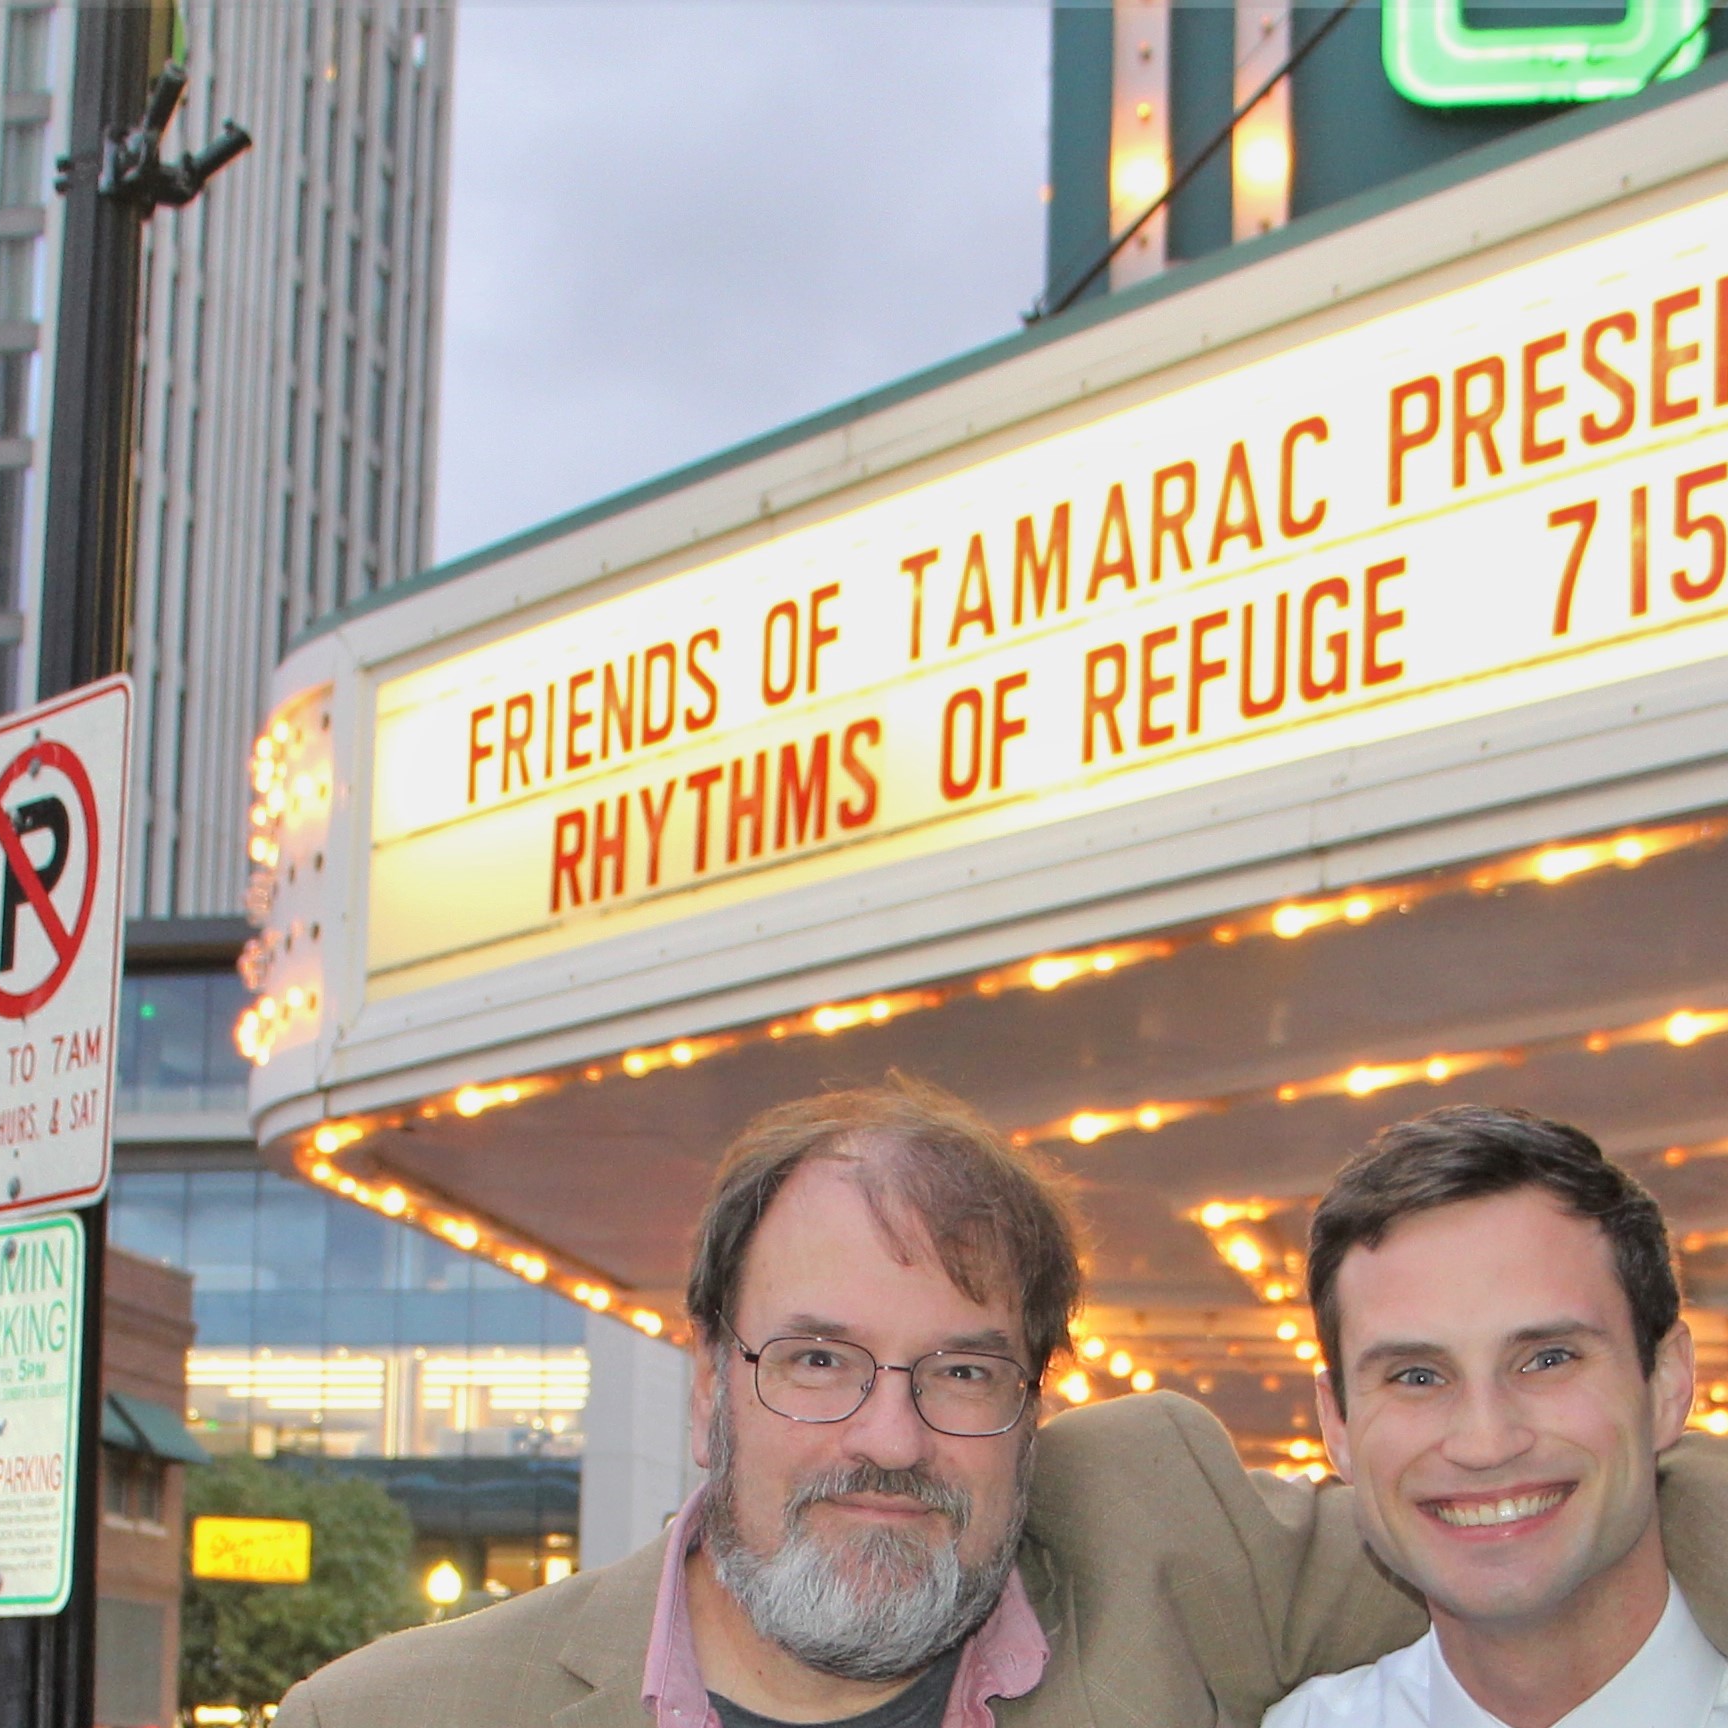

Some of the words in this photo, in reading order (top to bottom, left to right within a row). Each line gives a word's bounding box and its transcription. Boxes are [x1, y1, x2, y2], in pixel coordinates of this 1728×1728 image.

[467, 627, 720, 803] FRIENDS
[761, 583, 841, 707] OF
[900, 415, 1329, 662] TAMARAC
[549, 716, 882, 915] RHYTHMS
[938, 672, 1029, 803] OF
[1082, 557, 1407, 764] REFUGE
[8, 1042, 36, 1086] TO
[51, 1025, 103, 1074] 7AM
[48, 1098, 62, 1135] &
[69, 1088, 99, 1131] SAT
